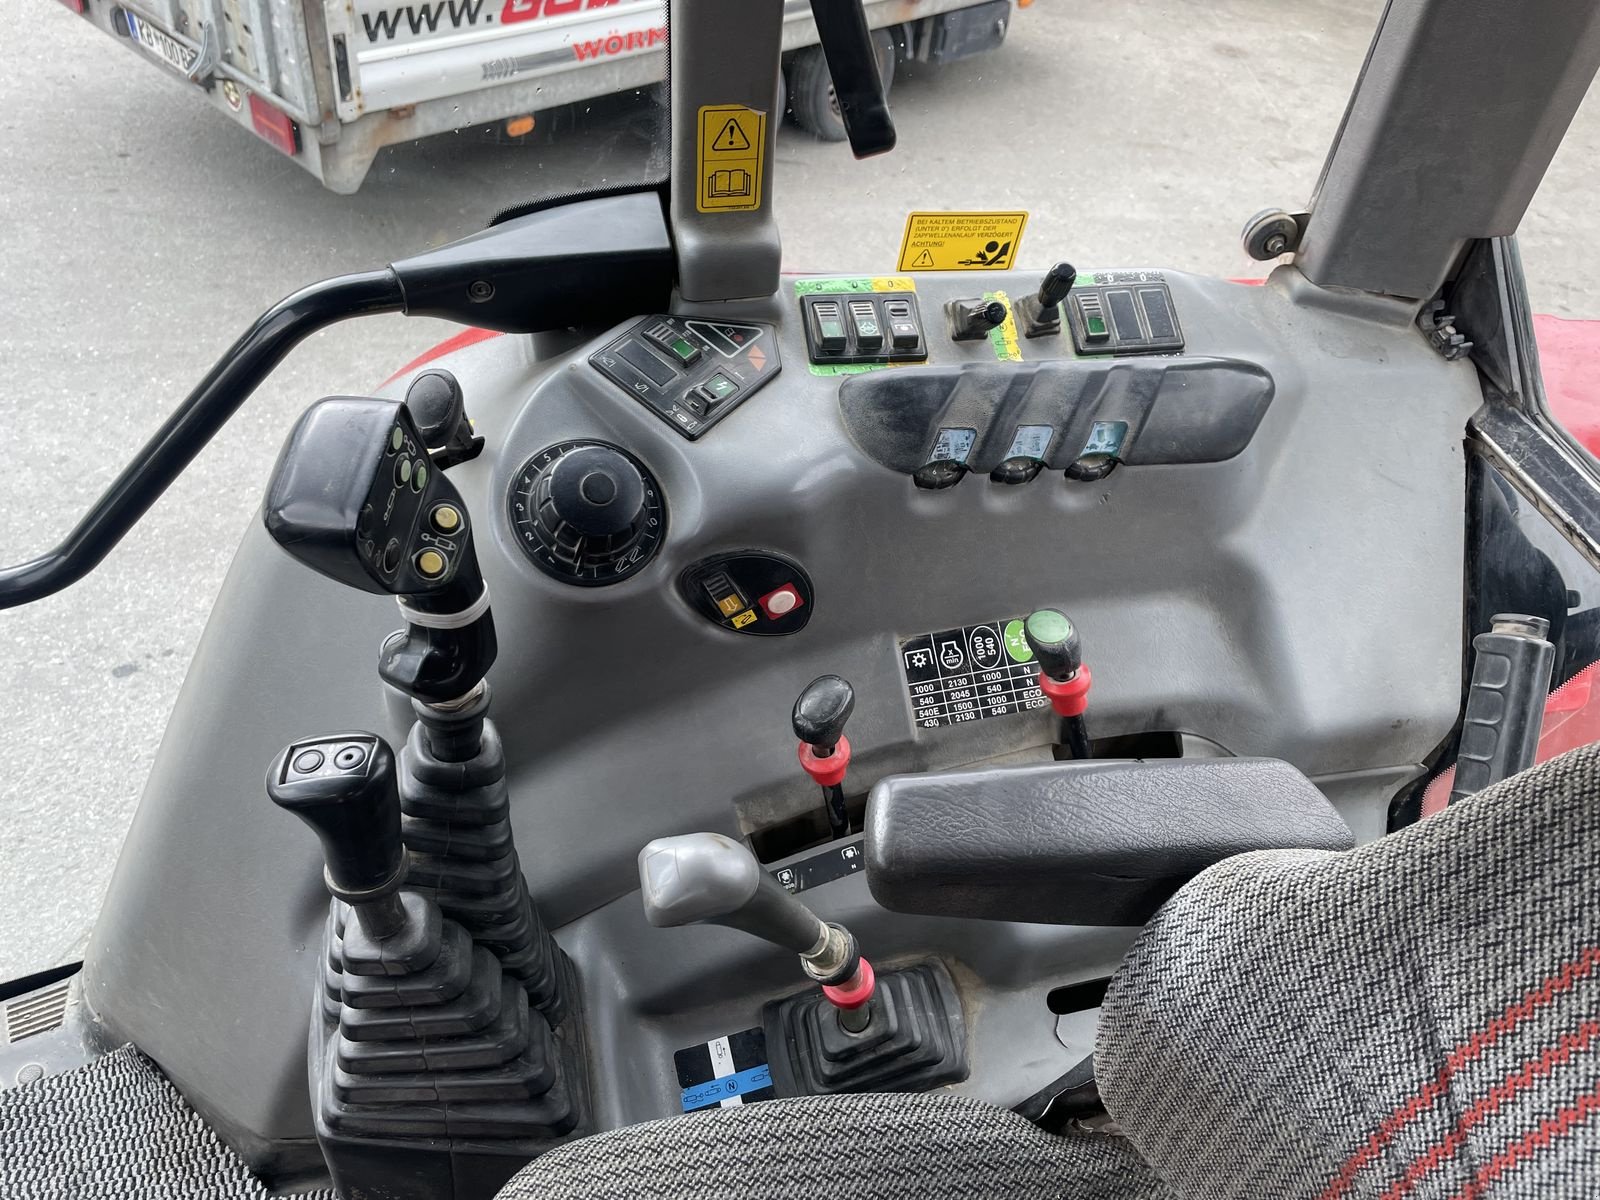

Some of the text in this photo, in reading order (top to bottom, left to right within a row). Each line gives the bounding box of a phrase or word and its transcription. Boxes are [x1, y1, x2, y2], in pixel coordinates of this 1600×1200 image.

[543, 454, 552, 462] 5
[515, 503, 525, 512] 3
[525, 531, 535, 542] 2
[974, 636, 986, 660] 1000
[985, 637, 996, 655] 540
[914, 666, 1031, 694] 1000 2130 1000 N
[919, 678, 1034, 705] 540 2045 540 N
[919, 689, 1042, 717] 540E 1500 1000 ECO
[924, 699, 1045, 728] 430 2130 540 ECO
[728, 1081, 736, 1090] N
